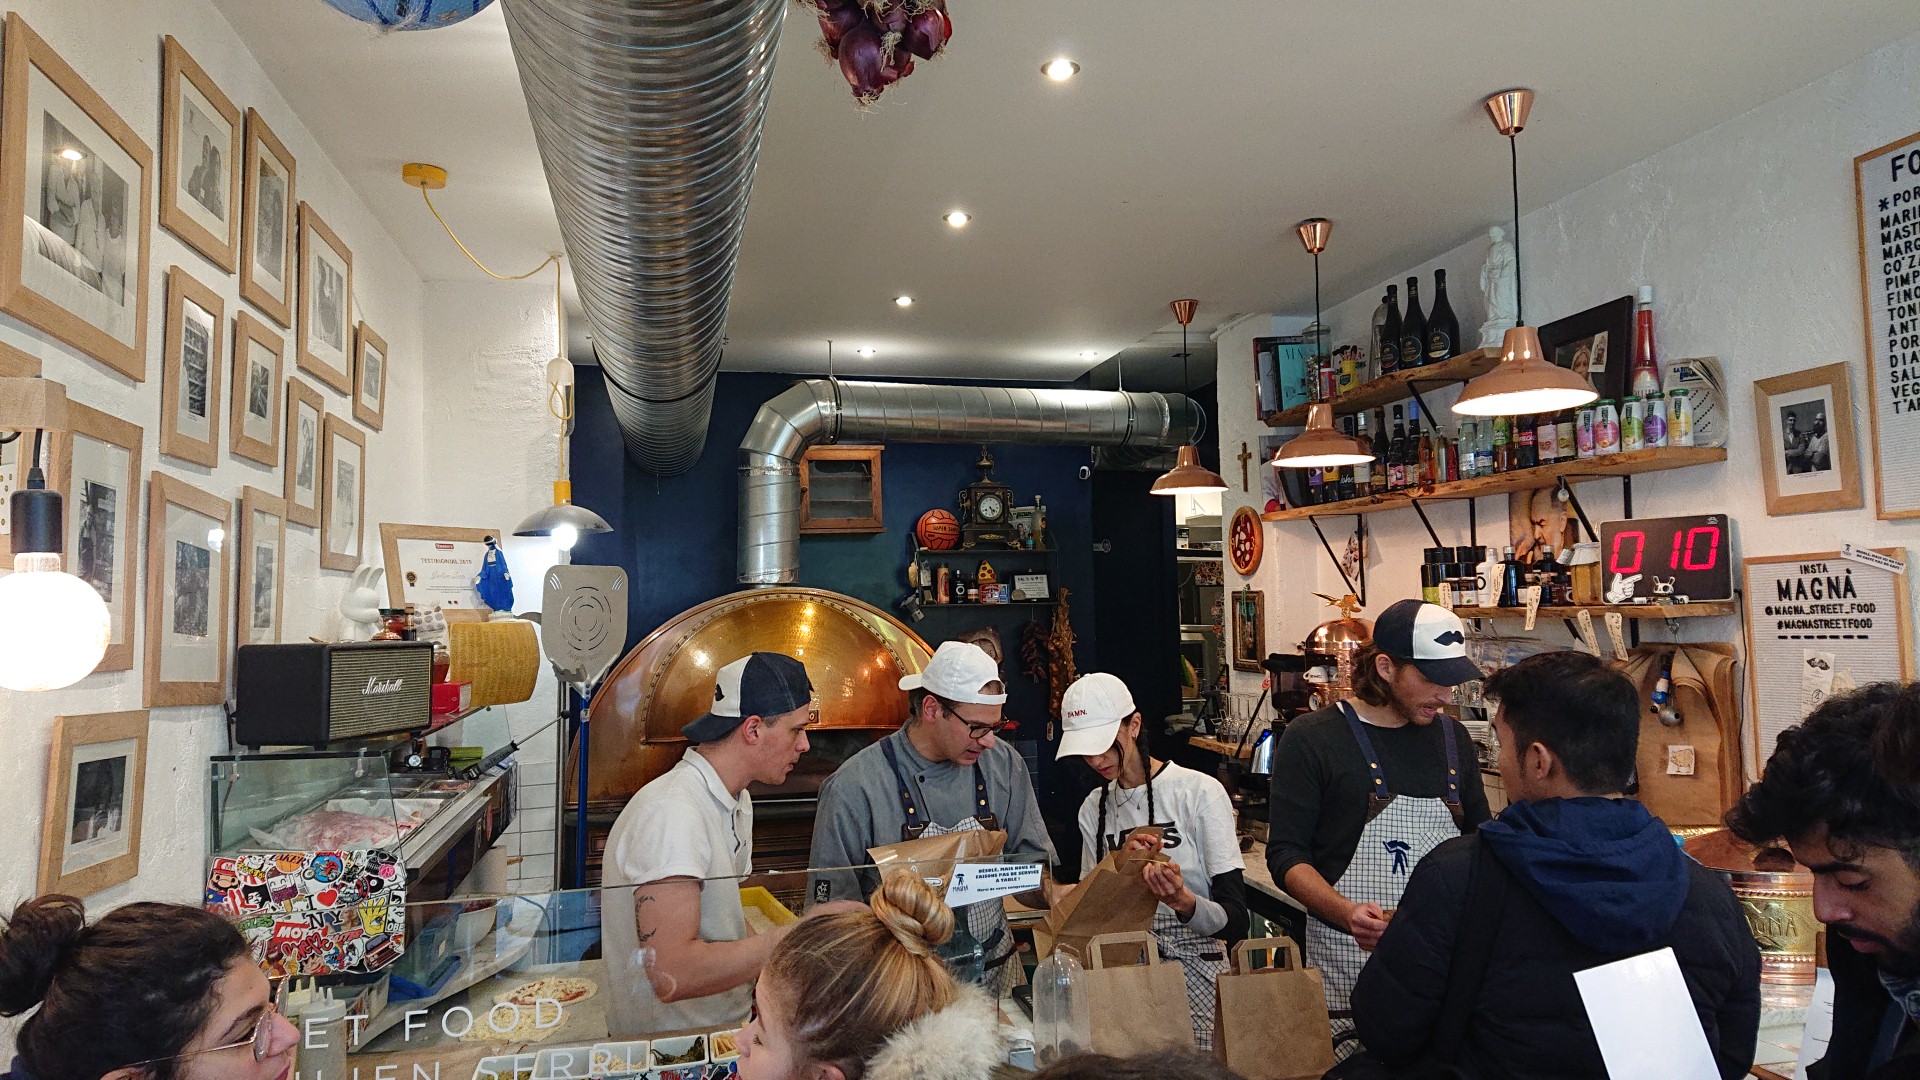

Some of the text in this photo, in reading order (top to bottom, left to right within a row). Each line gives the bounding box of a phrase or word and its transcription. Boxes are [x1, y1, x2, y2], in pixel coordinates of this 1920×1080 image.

[1891, 149, 1920, 182] FO
[1881, 204, 1920, 230] MARI
[1881, 221, 1920, 245] MAST
[1883, 254, 1920, 275] CO'Z
[1886, 270, 1920, 291] PIMP
[1888, 302, 1920, 321] TON
[1888, 318, 1919, 337] ANT
[1889, 334, 1920, 352] POR
[1889, 350, 1920, 368] DIA
[1891, 366, 1920, 384] SAL
[1891, 382, 1920, 399] VEG
[1609, 526, 1720, 574] 0 10
[1800, 563, 1828, 574] INSTA
[1765, 602, 1876, 616] @MAGNA_STREET_FOOD
[1777, 618, 1873, 630] #MAGNASTREETFOOD
[362, 677, 403, 695] Marshall
[1067, 709, 1088, 719] DAMN.
[305, 894, 317, 911] I
[305, 998, 564, 1050] ET FOOD
